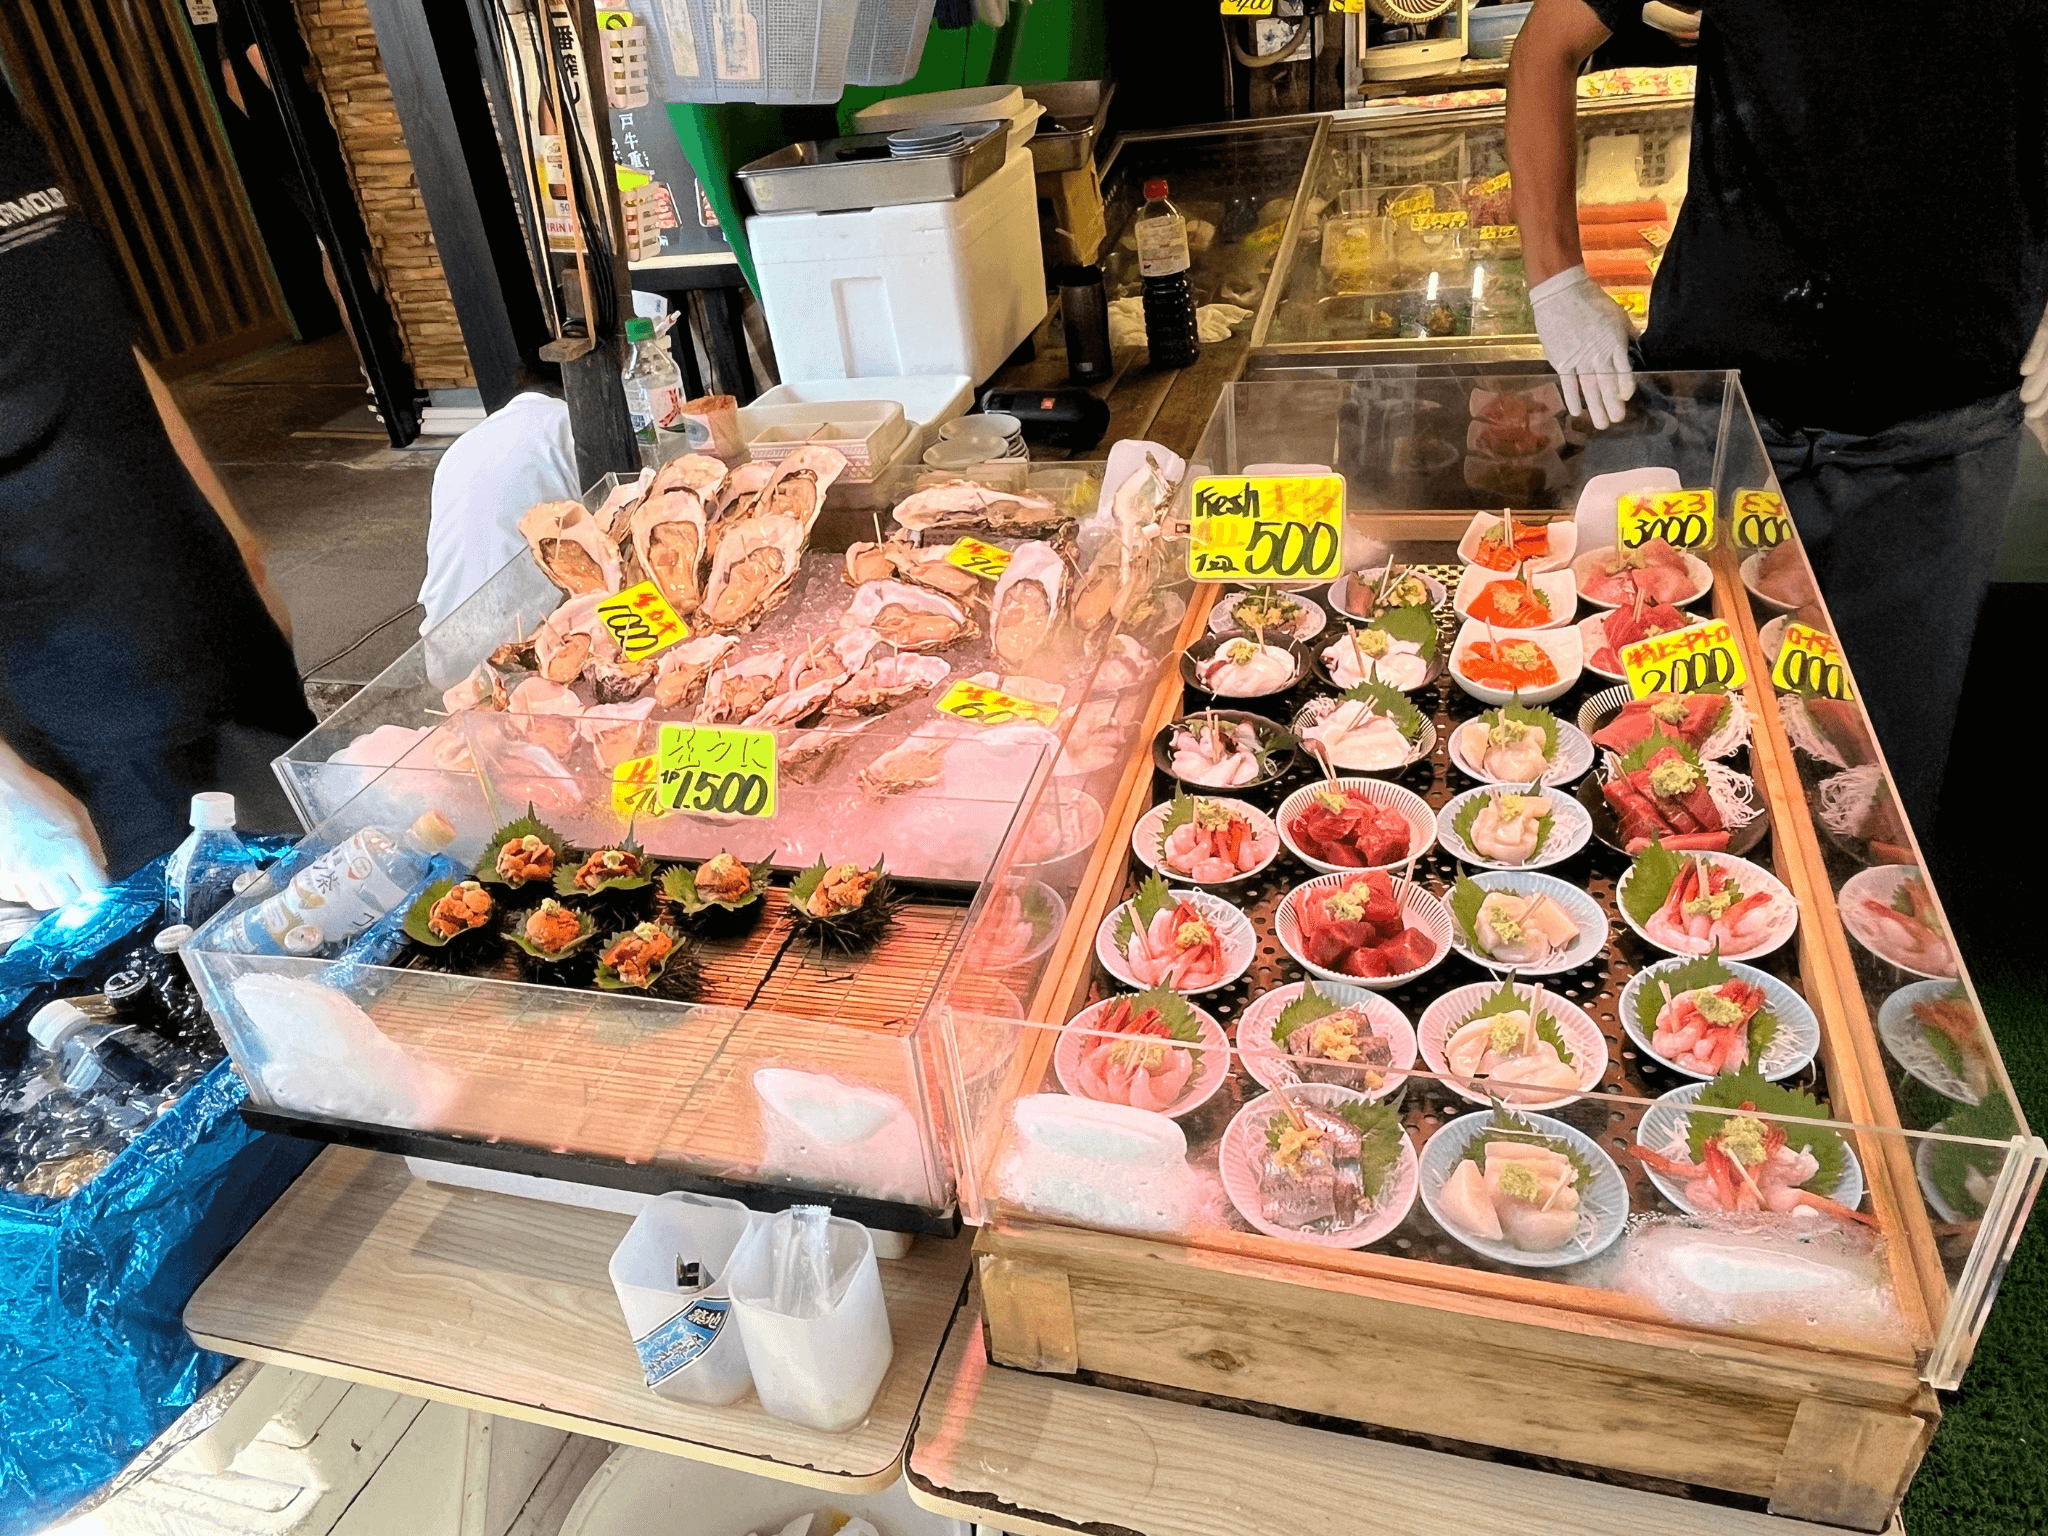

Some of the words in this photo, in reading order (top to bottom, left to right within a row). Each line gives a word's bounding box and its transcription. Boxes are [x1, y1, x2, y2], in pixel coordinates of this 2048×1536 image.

[0, 187, 68, 227] RMOU
[546, 223, 566, 233] IRIN
[1195, 482, 1260, 518] Fresh
[1245, 521, 1338, 576] 500
[1623, 514, 1707, 549] 3000
[598, 605, 659, 652] 1000
[1641, 647, 1735, 694] 2000
